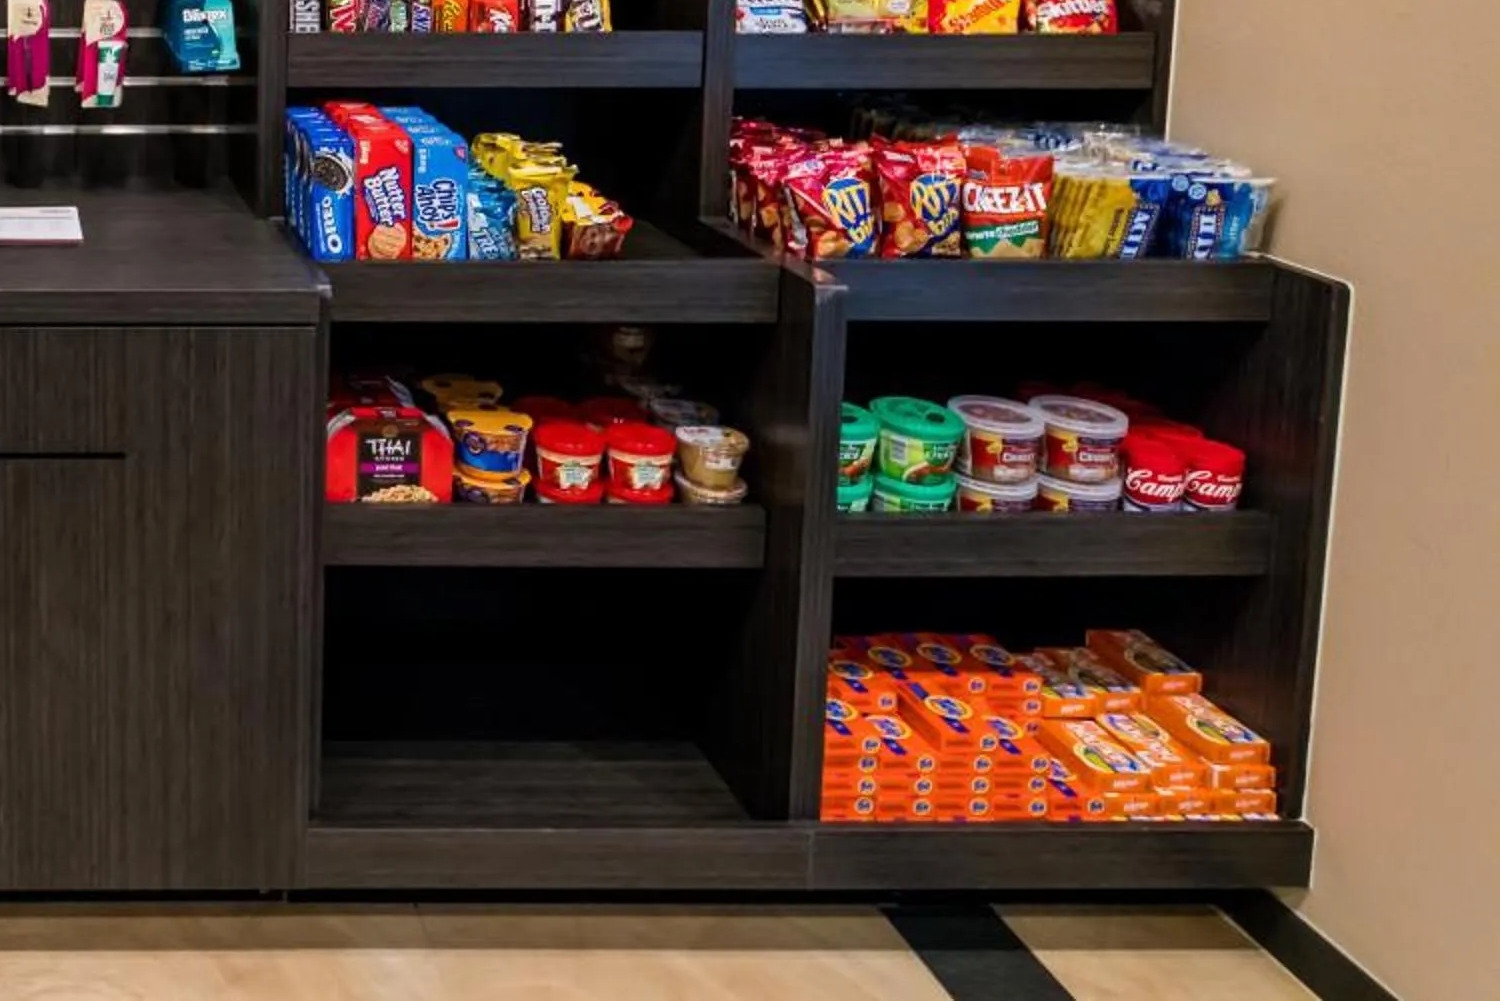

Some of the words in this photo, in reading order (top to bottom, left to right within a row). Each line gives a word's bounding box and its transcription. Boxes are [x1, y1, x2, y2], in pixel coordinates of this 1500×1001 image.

[364, 176, 394, 228] Butter
[379, 166, 406, 220] Nutter
[431, 179, 456, 220] Chips
[366, 439, 412, 456] THAI
